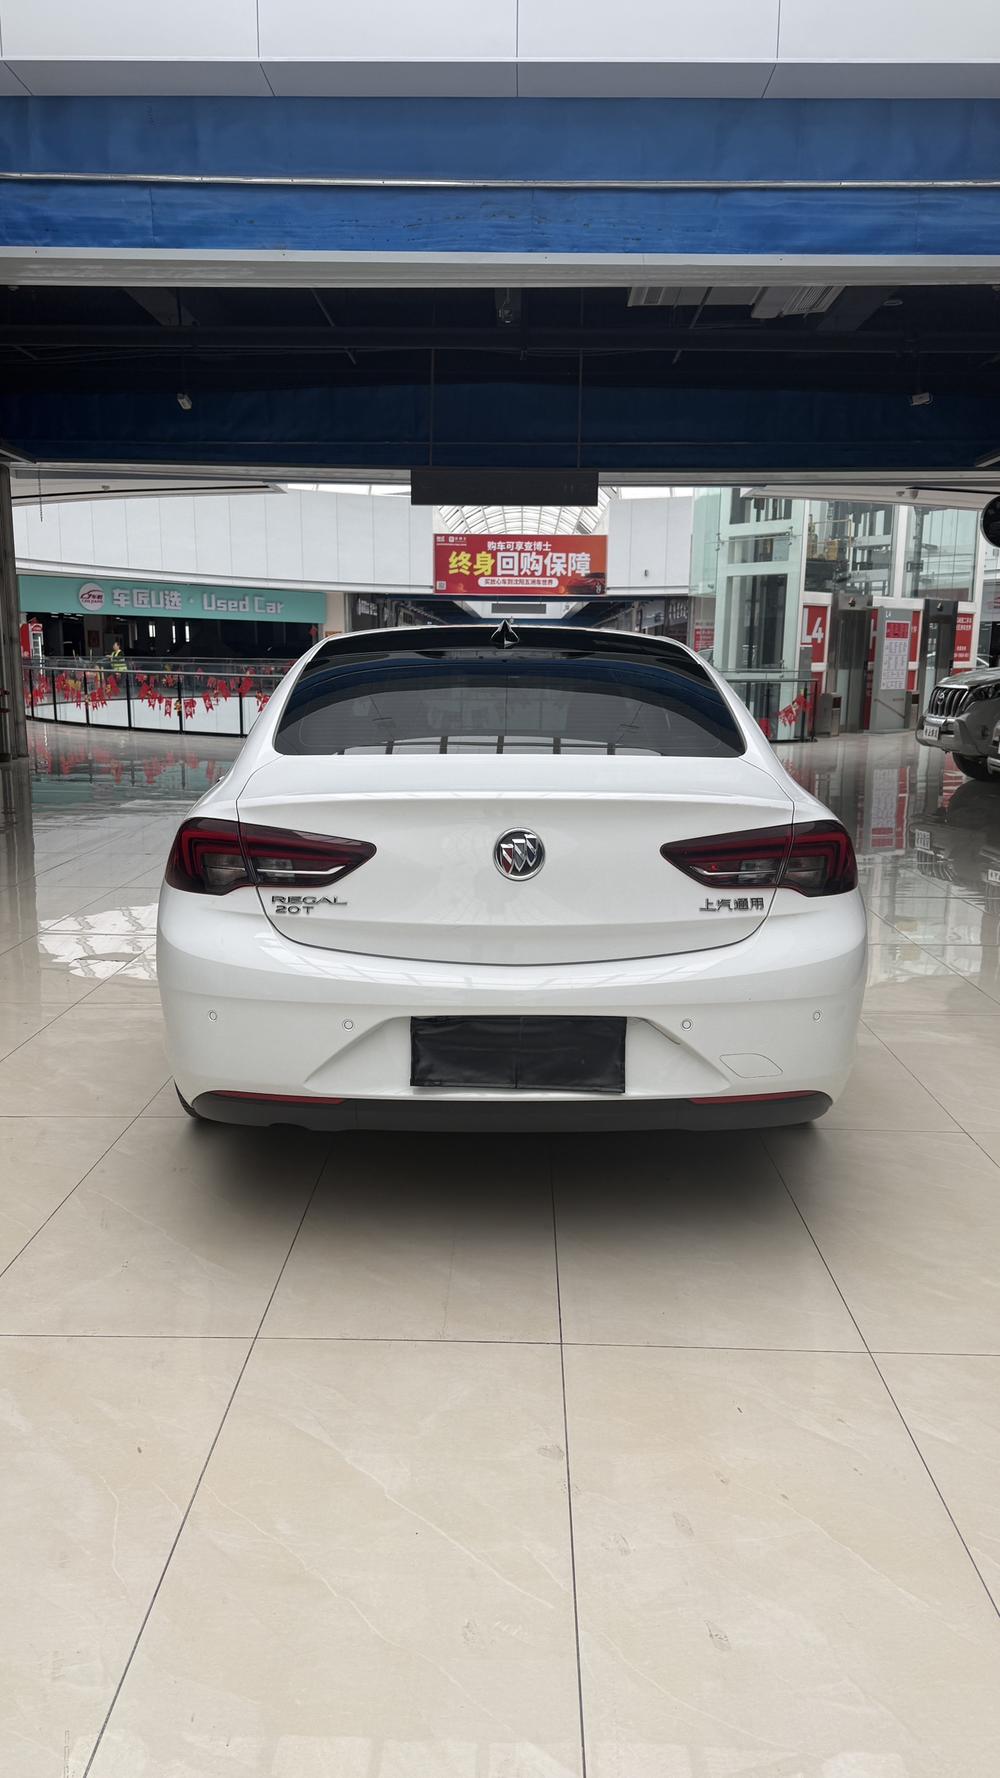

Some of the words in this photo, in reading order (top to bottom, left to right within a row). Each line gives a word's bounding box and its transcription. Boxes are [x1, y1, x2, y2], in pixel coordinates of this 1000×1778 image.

[487, 541, 552, 552] 购车可享查博士
[448, 551, 591, 577] 终身回购保障
[112, 588, 182, 610] 车匠U选
[203, 594, 250, 612] Used
[254, 596, 284, 614] Car
[801, 607, 824, 643] L4
[271, 895, 348, 906] REGAL
[699, 897, 765, 912] 上汽通用
[275, 905, 315, 915] 20T
